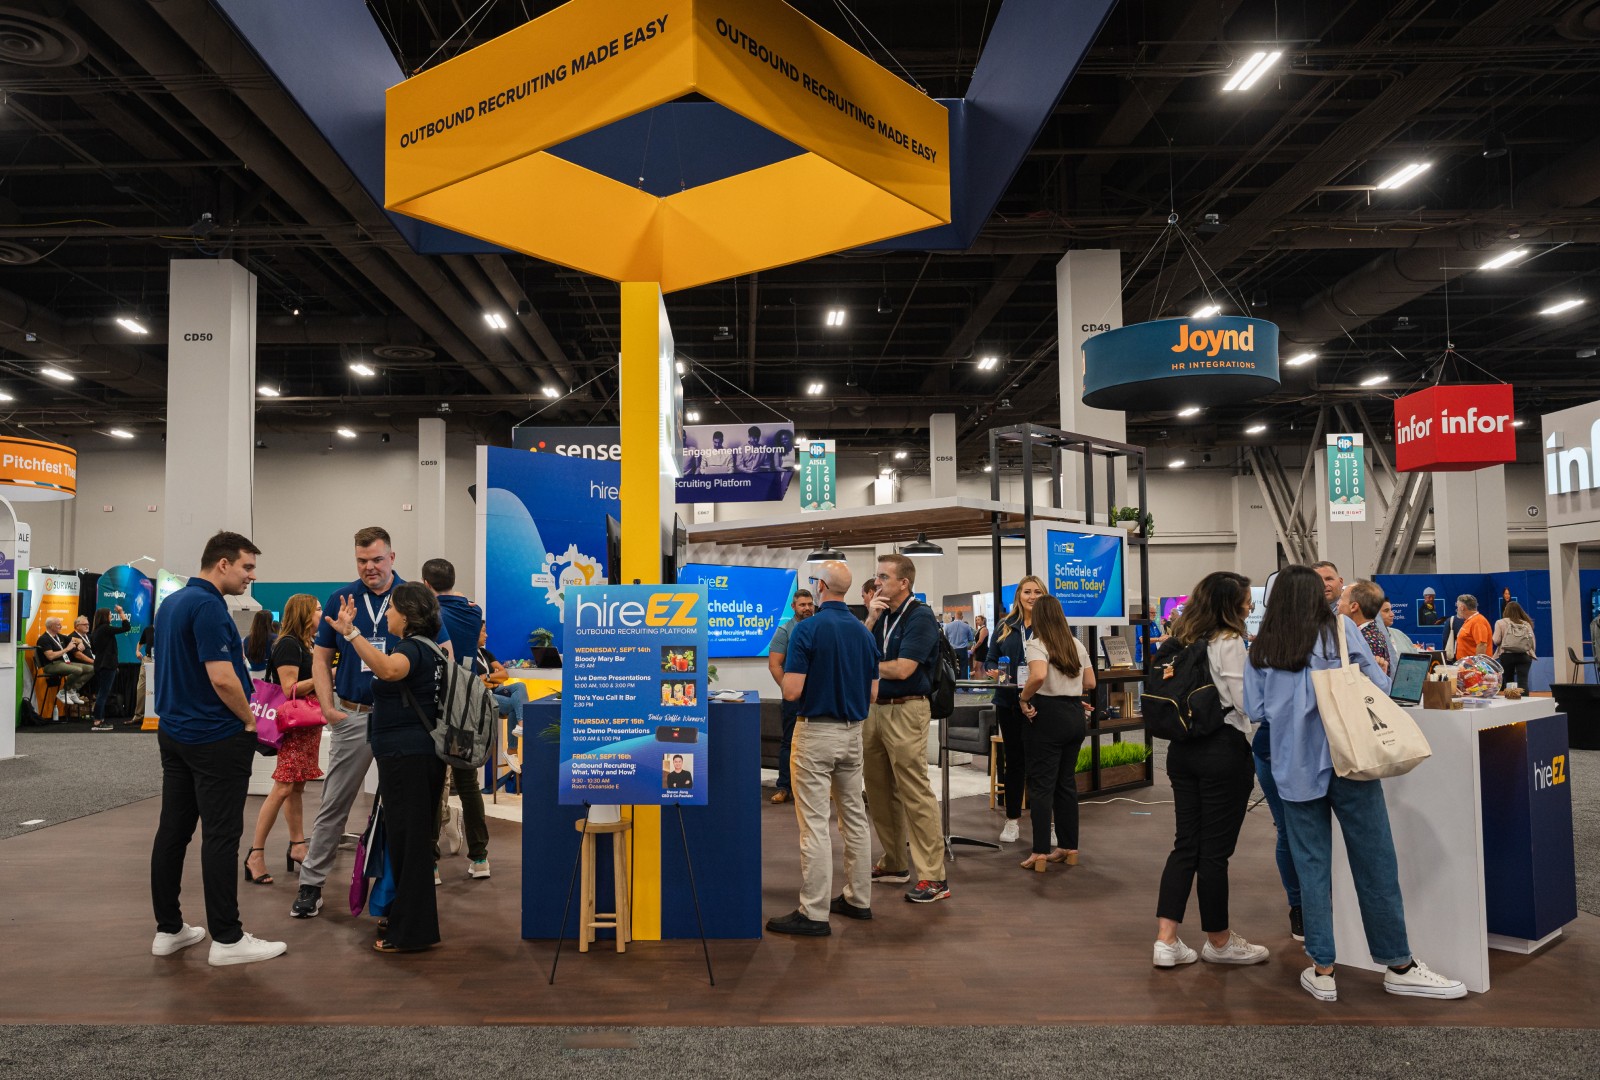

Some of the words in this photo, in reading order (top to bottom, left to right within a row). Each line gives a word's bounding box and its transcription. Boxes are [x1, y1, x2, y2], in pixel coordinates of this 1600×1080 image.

[400, 106, 475, 148] OUTBOUND
[478, 65, 567, 117] RECRUITING
[571, 39, 619, 75] MADE
[623, 14, 669, 51] EASY
[716, 18, 799, 83] OUTBOUND
[803, 72, 875, 130] RECRUITING
[878, 120, 909, 150] MADE
[911, 138, 937, 164] EASY
[1081, 324, 1111, 332] CD49
[184, 333, 213, 341] CD50
[1171, 324, 1254, 357] Joynd
[1189, 361, 1255, 370] INTEGRATIONS
[1441, 407, 1509, 434] infor
[1397, 414, 1433, 444] infor
[555, 444, 621, 461] sense
[682, 447, 742, 458] Engagement
[745, 445, 785, 454] Platform
[3, 454, 62, 474] Pitchfest
[590, 480, 620, 500] hire
[675, 479, 711, 490] ecruiting
[714, 479, 751, 488] Platform
[18, 533, 29, 542] ALE
[1055, 563, 1091, 577] Schedule
[1092, 568, 1098, 577] a
[53, 581, 77, 590] SURVALE
[698, 576, 728, 588] hireEZ
[1055, 578, 1078, 590] Demo
[1080, 578, 1105, 593] Today!
[576, 593, 699, 627] hireEZ
[708, 600, 753, 613] chedule
[756, 603, 763, 613] a
[708, 617, 735, 627] emo
[737, 614, 774, 630] Today!
[664, 714, 681, 722] Raffle
[682, 715, 706, 723] Winners!
[1534, 755, 1565, 790] hireEZ
